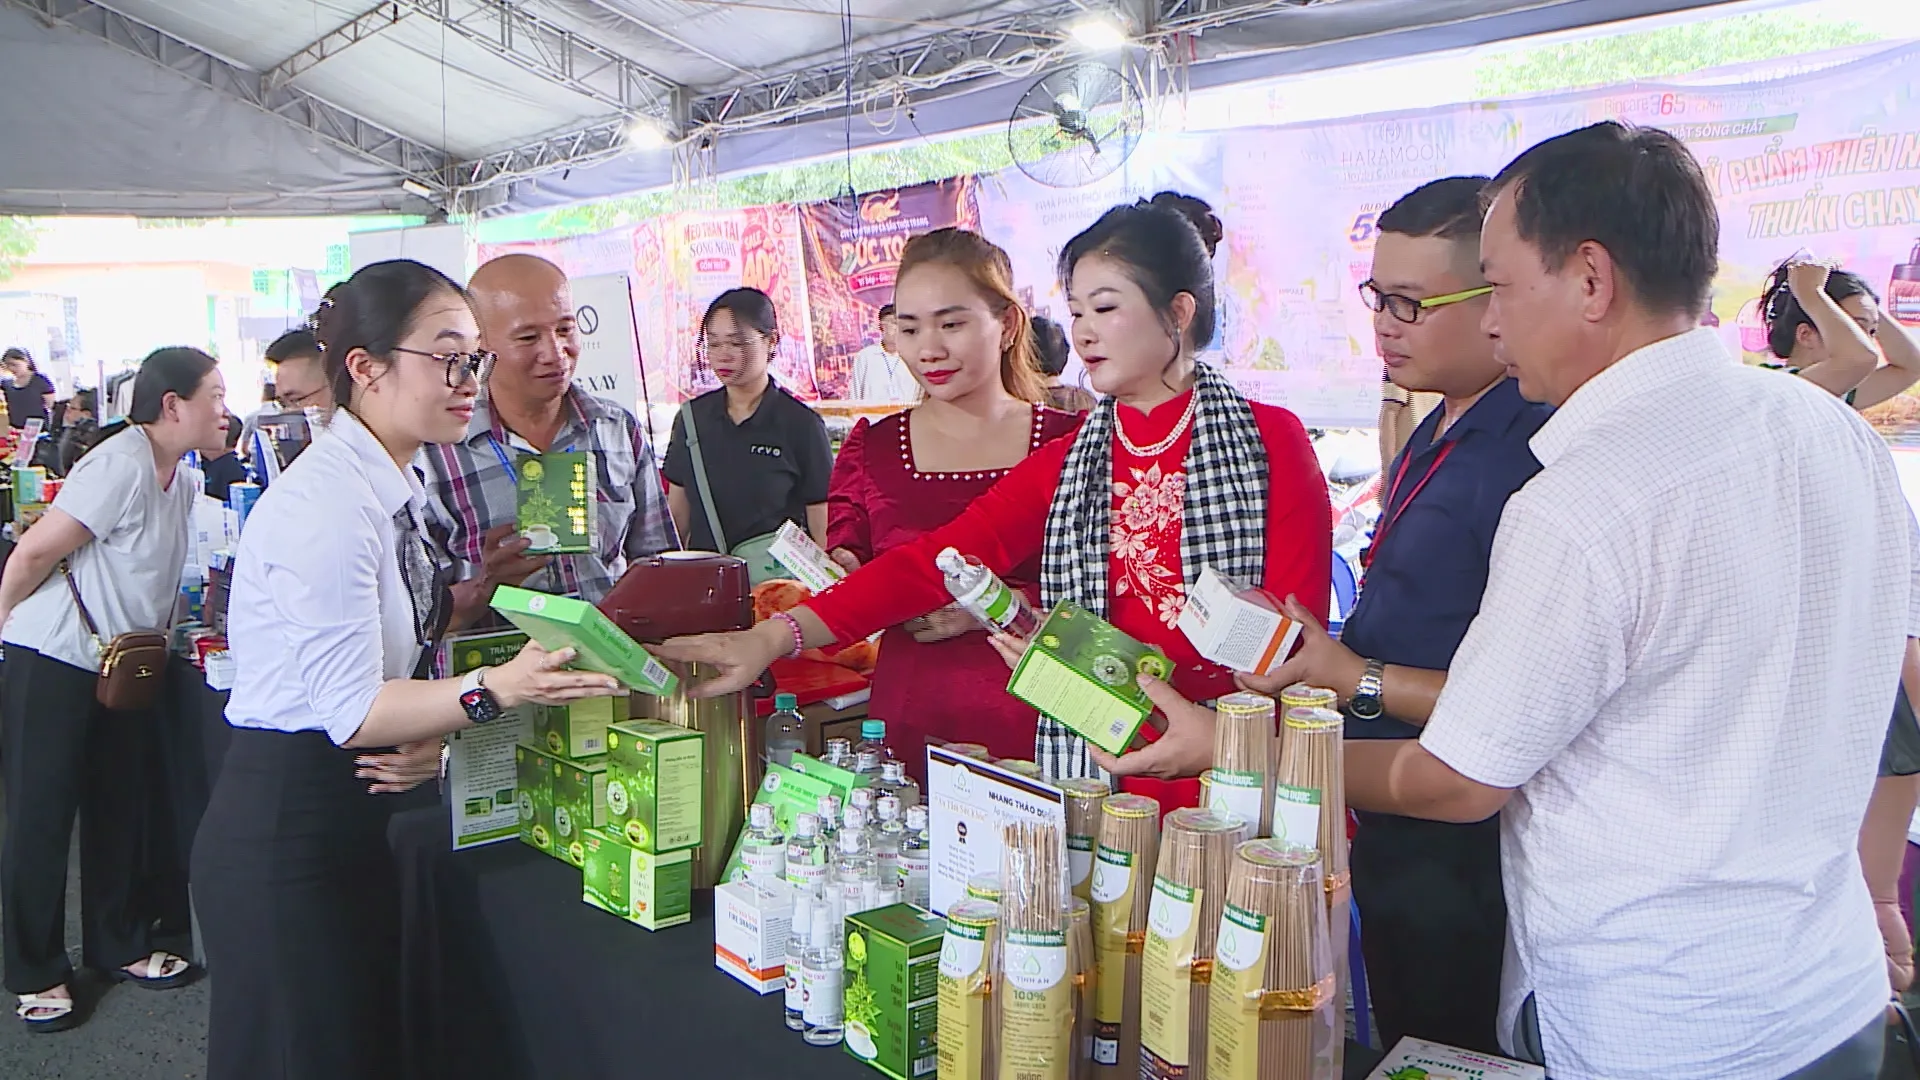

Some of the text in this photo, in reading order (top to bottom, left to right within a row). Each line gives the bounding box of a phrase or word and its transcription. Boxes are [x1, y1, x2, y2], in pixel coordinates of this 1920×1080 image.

[1341, 143, 1447, 168] HARAMOON
[1703, 155, 1723, 199] Ỹ
[1728, 135, 1809, 195] PHẨM
[1813, 124, 1898, 179] THIÊN
[1747, 182, 1920, 239] THUẦN CHAY
[588, 374, 618, 392] XAY
[751, 445, 781, 457] revo
[988, 790, 1014, 807] NHANG
[1014, 798, 1036, 815] THẢO
[1149, 931, 1169, 950] 100%
[938, 973, 959, 989] 00%
[1217, 960, 1237, 982] 100%
[1013, 990, 1047, 1002] 100%
[1403, 1054, 1485, 1077] Coconut
